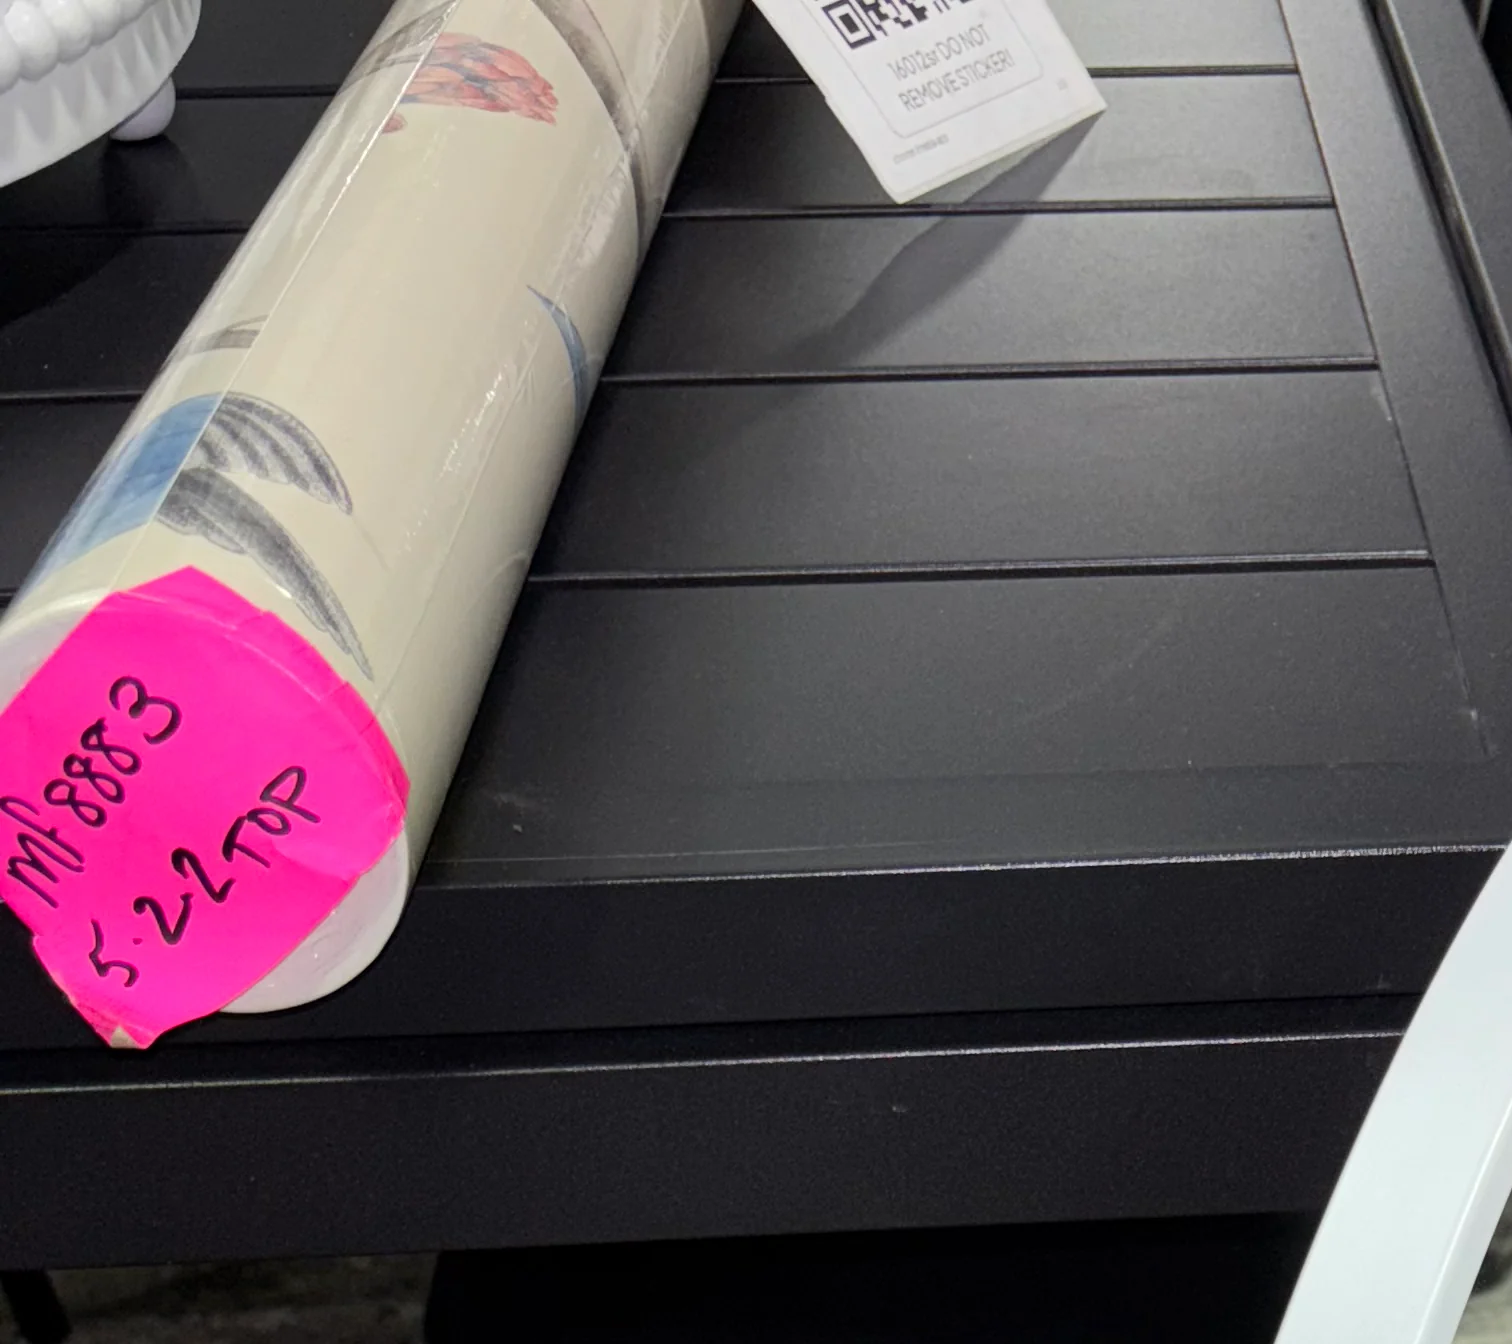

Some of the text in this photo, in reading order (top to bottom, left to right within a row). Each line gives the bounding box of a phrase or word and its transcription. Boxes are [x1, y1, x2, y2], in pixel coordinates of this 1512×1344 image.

[935, 36, 962, 60] DO
[958, 23, 991, 51] NOT
[898, 72, 961, 112] REMOVE
[222, 766, 321, 869] TOP
